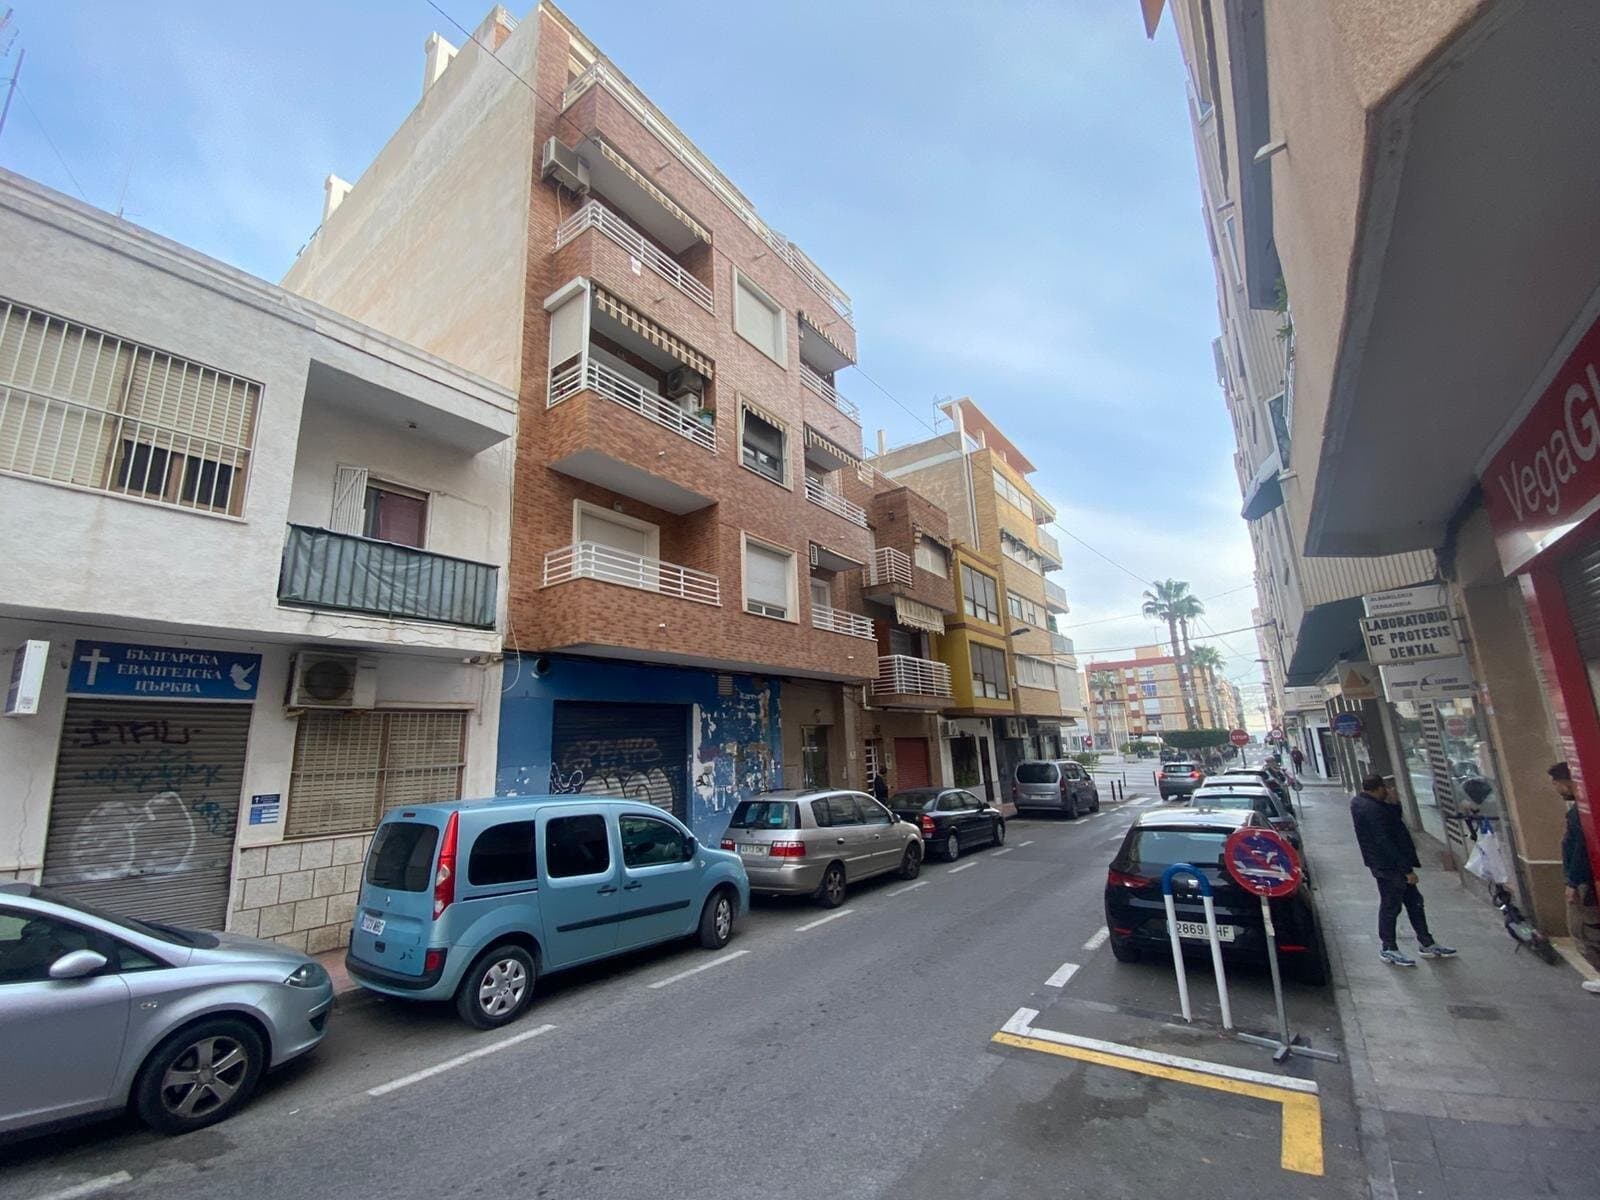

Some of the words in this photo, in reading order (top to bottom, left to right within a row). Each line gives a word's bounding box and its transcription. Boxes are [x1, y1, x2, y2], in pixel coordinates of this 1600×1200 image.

[1365, 610, 1448, 632] LABORATORIO
[1369, 633, 1386, 647] DE
[1390, 625, 1451, 644] PROTESIS
[126, 648, 220, 666] БЪЛГАРСКА
[1389, 643, 1440, 660] DENTAL
[117, 663, 223, 680] ЕВАНГЕЛСКА
[134, 680, 201, 694] ЦЪРКВА
[1176, 923, 1204, 935] 2869
